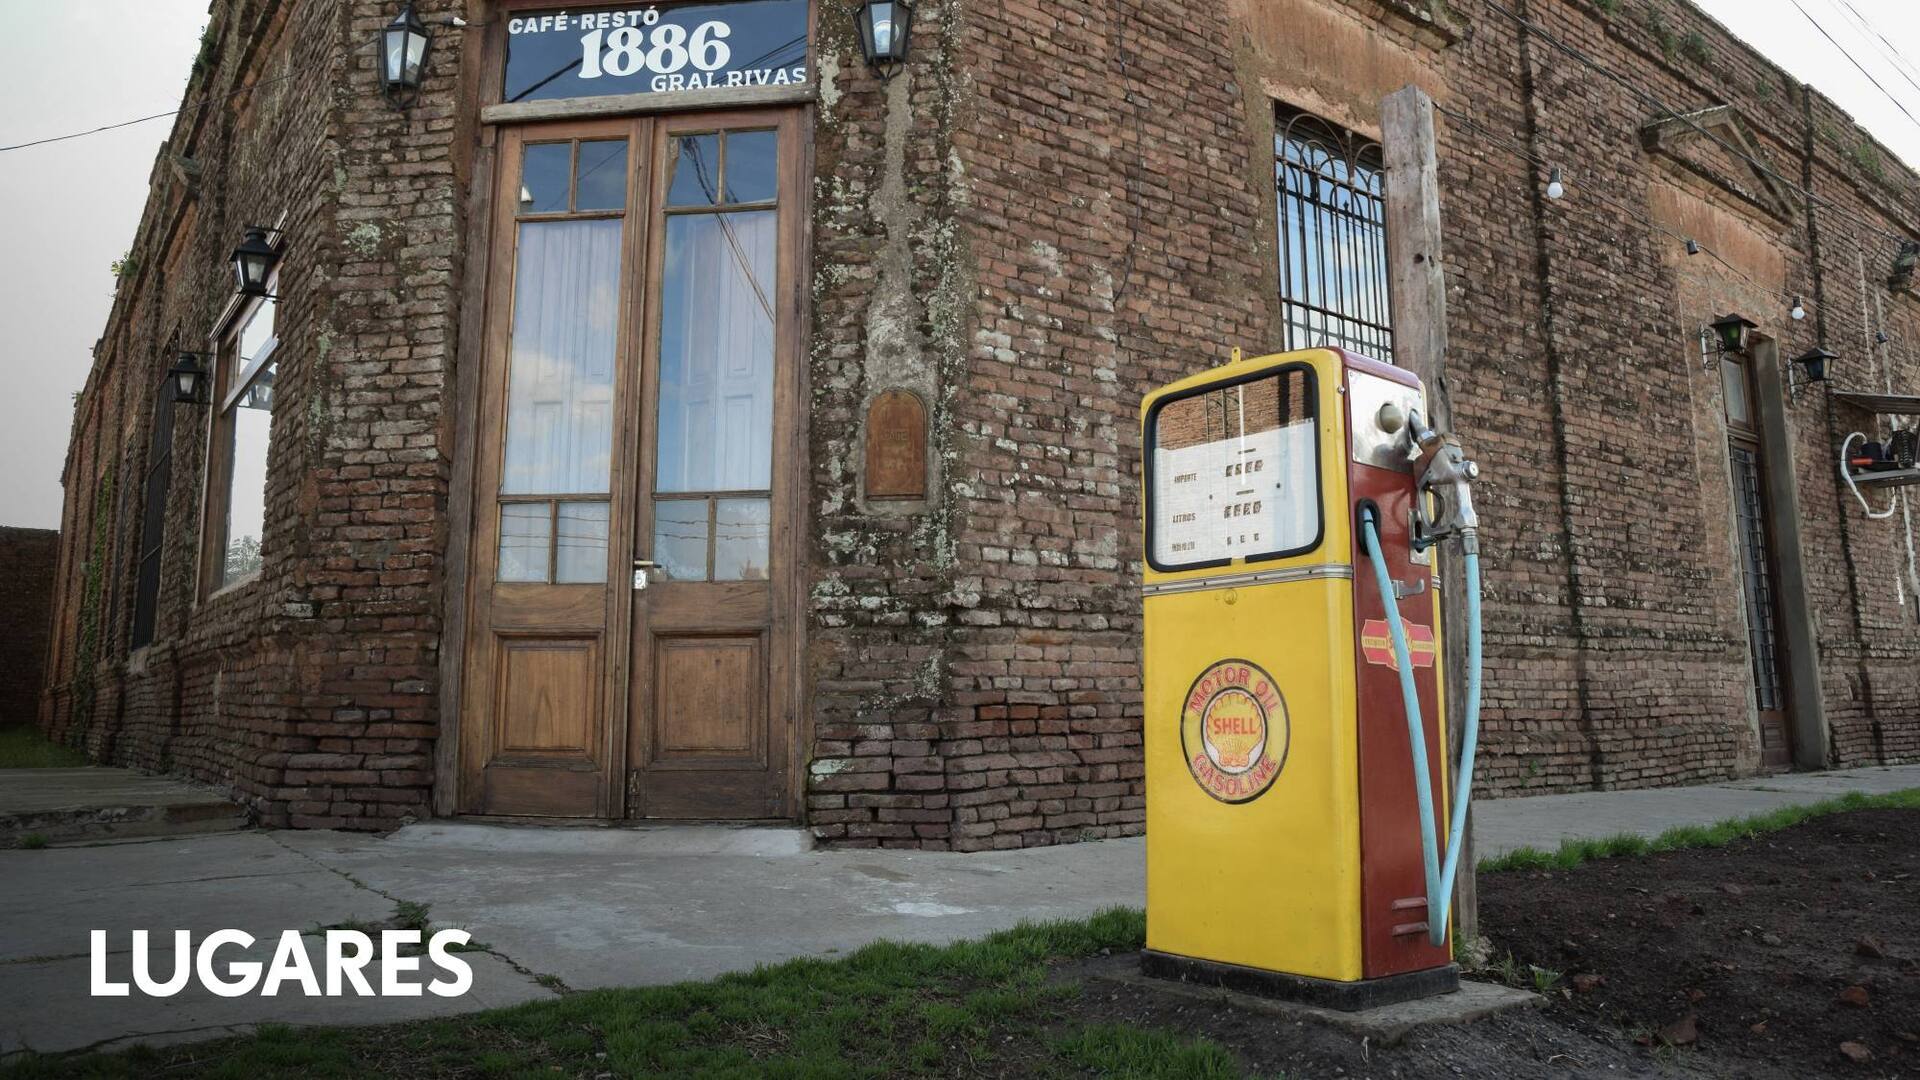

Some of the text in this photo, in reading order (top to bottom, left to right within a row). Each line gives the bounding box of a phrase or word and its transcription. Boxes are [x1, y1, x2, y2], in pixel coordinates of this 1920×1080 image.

[578, 20, 731, 79] 1886
[1173, 512, 1196, 523] LITROS
[1190, 667, 1278, 717] MOTOR OIL
[1213, 717, 1257, 735] SHELL
[1194, 754, 1276, 796] GASOLINE
